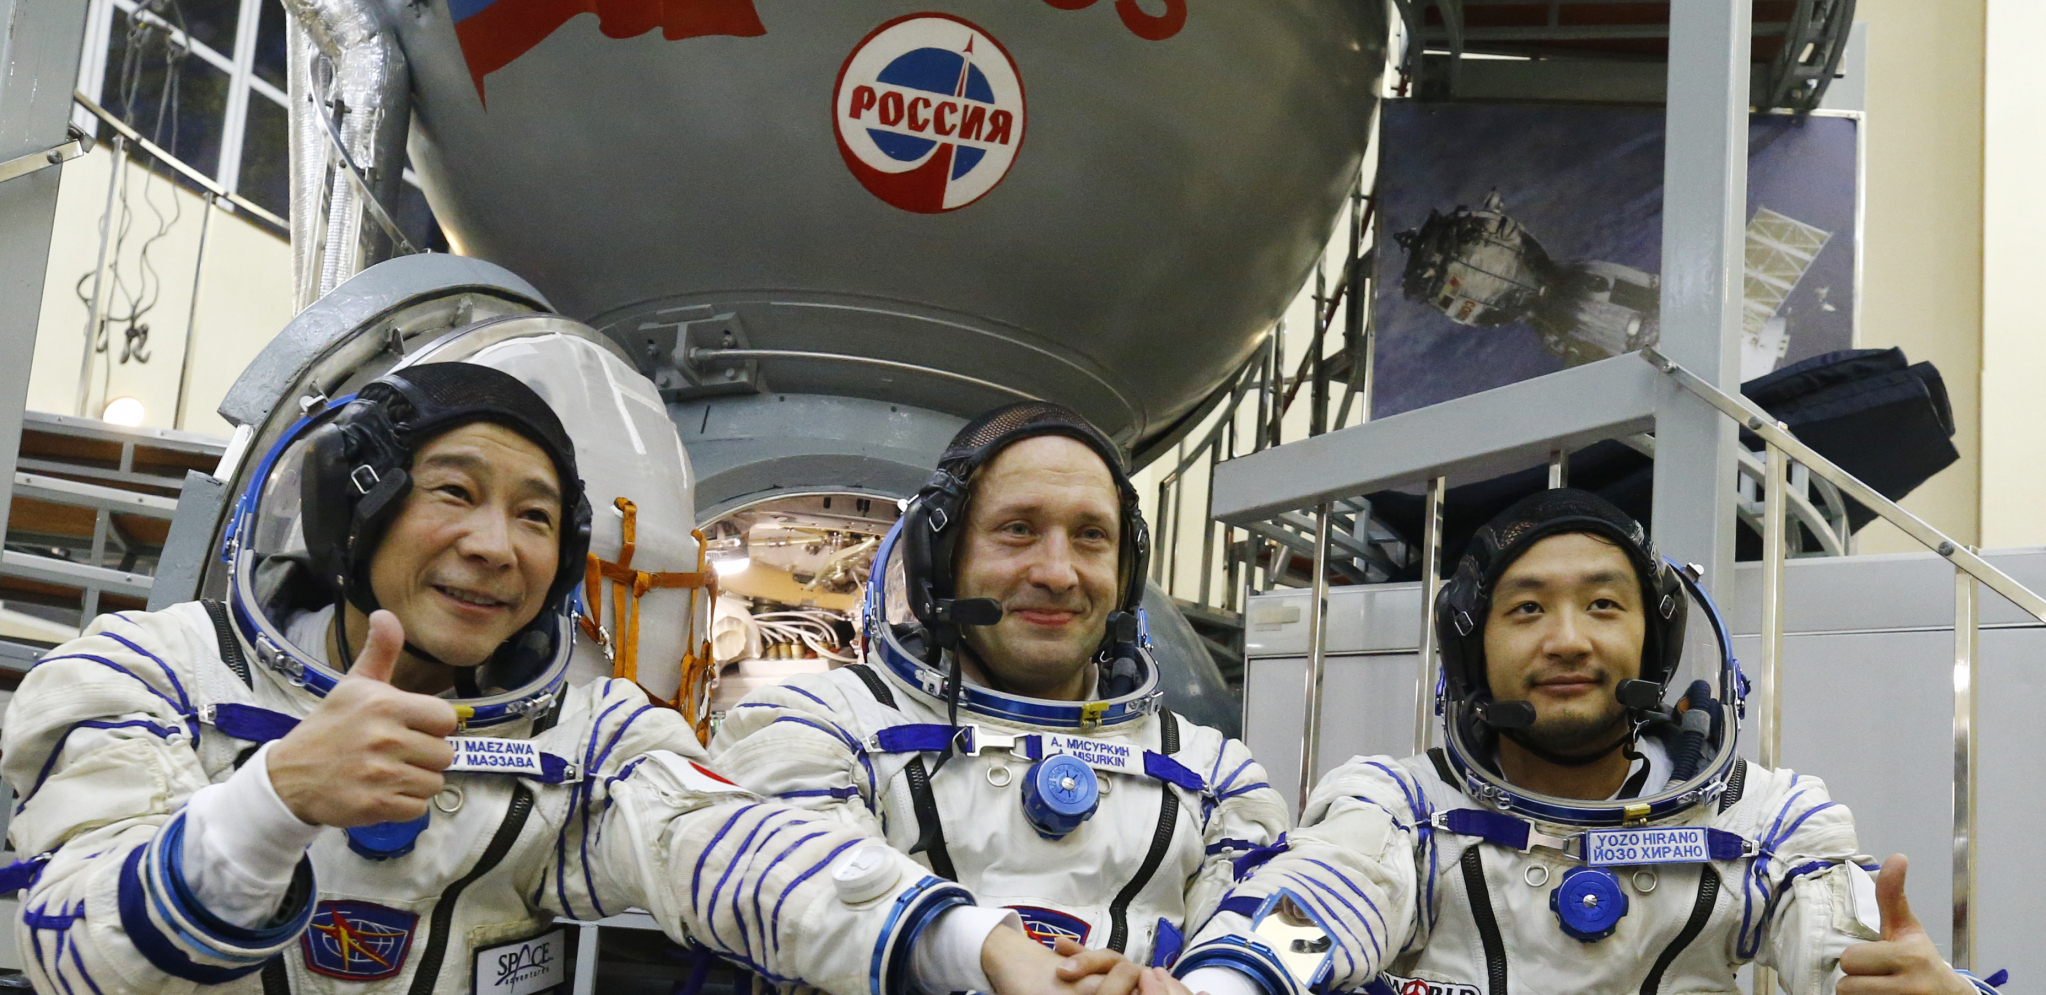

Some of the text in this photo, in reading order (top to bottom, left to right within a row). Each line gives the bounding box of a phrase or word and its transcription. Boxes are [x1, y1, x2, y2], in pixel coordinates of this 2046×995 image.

[849, 85, 1013, 145] РОССИЯ
[465, 741, 534, 755] MAEZAWA
[1051, 737, 1062, 747] А.
[1067, 738, 1129, 757] МИСУРКИН
[467, 754, 535, 769] МАЭЗАВА
[1597, 832, 1698, 848] YOZO HIRANO
[1594, 846, 1703, 861] ЙОЗО ХИРАНО
[497, 942, 549, 977] SPACE
